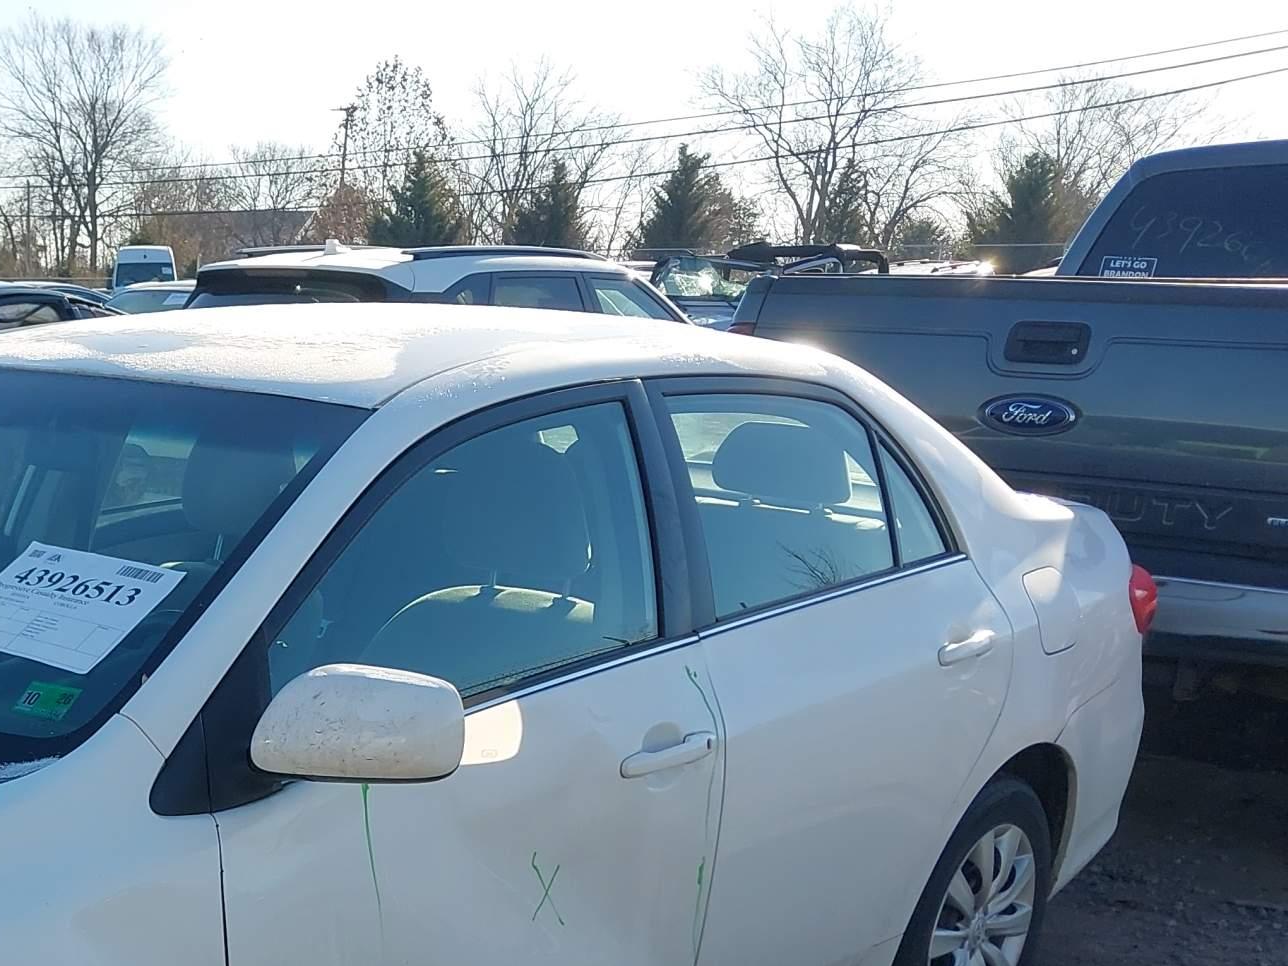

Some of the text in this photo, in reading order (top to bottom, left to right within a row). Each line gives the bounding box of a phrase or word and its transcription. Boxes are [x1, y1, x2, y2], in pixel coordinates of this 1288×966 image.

[1109, 259, 1147, 269] LET'S GO
[1103, 269, 1149, 279] BRANDON
[1002, 402, 1052, 425] Ford
[14, 567, 142, 606] 43926513
[23, 691, 41, 706] 10
